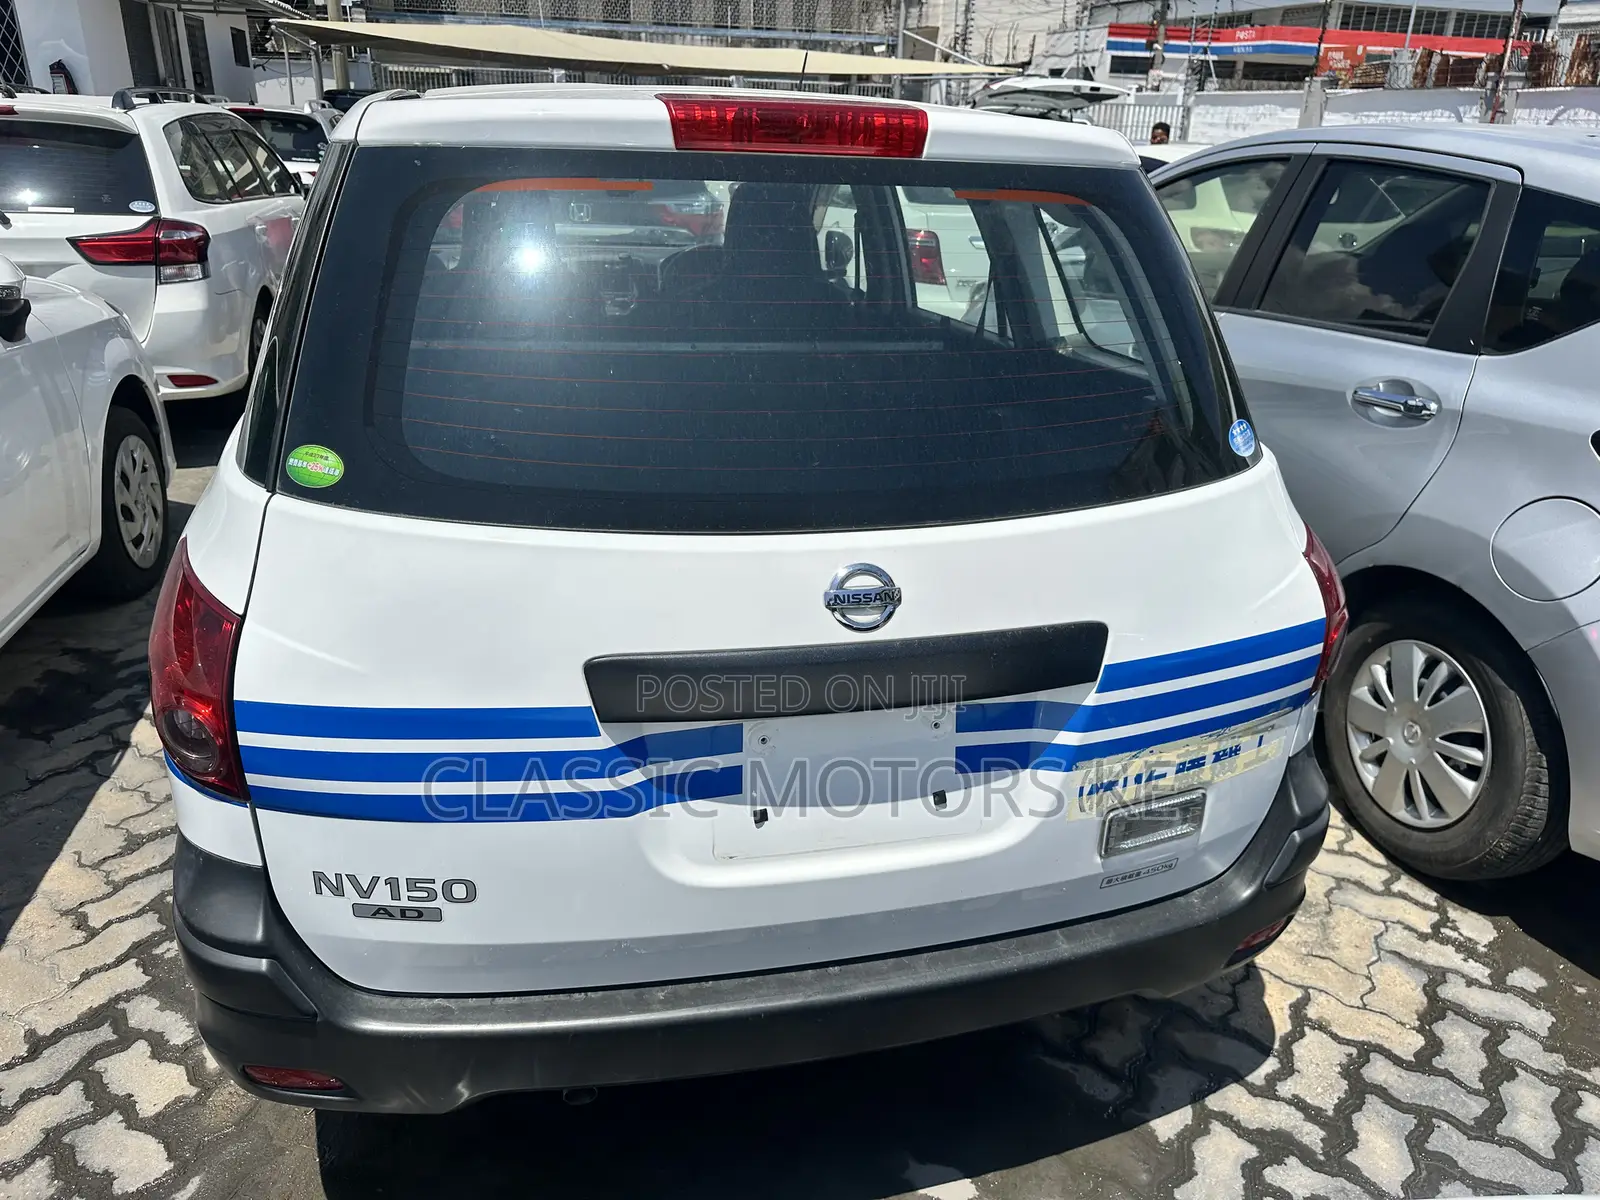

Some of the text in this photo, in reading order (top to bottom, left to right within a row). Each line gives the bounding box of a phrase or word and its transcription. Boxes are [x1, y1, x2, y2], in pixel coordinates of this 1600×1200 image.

[833, 590, 895, 605] NISSAN
[312, 871, 477, 904] NV150
[370, 907, 425, 919] AD
